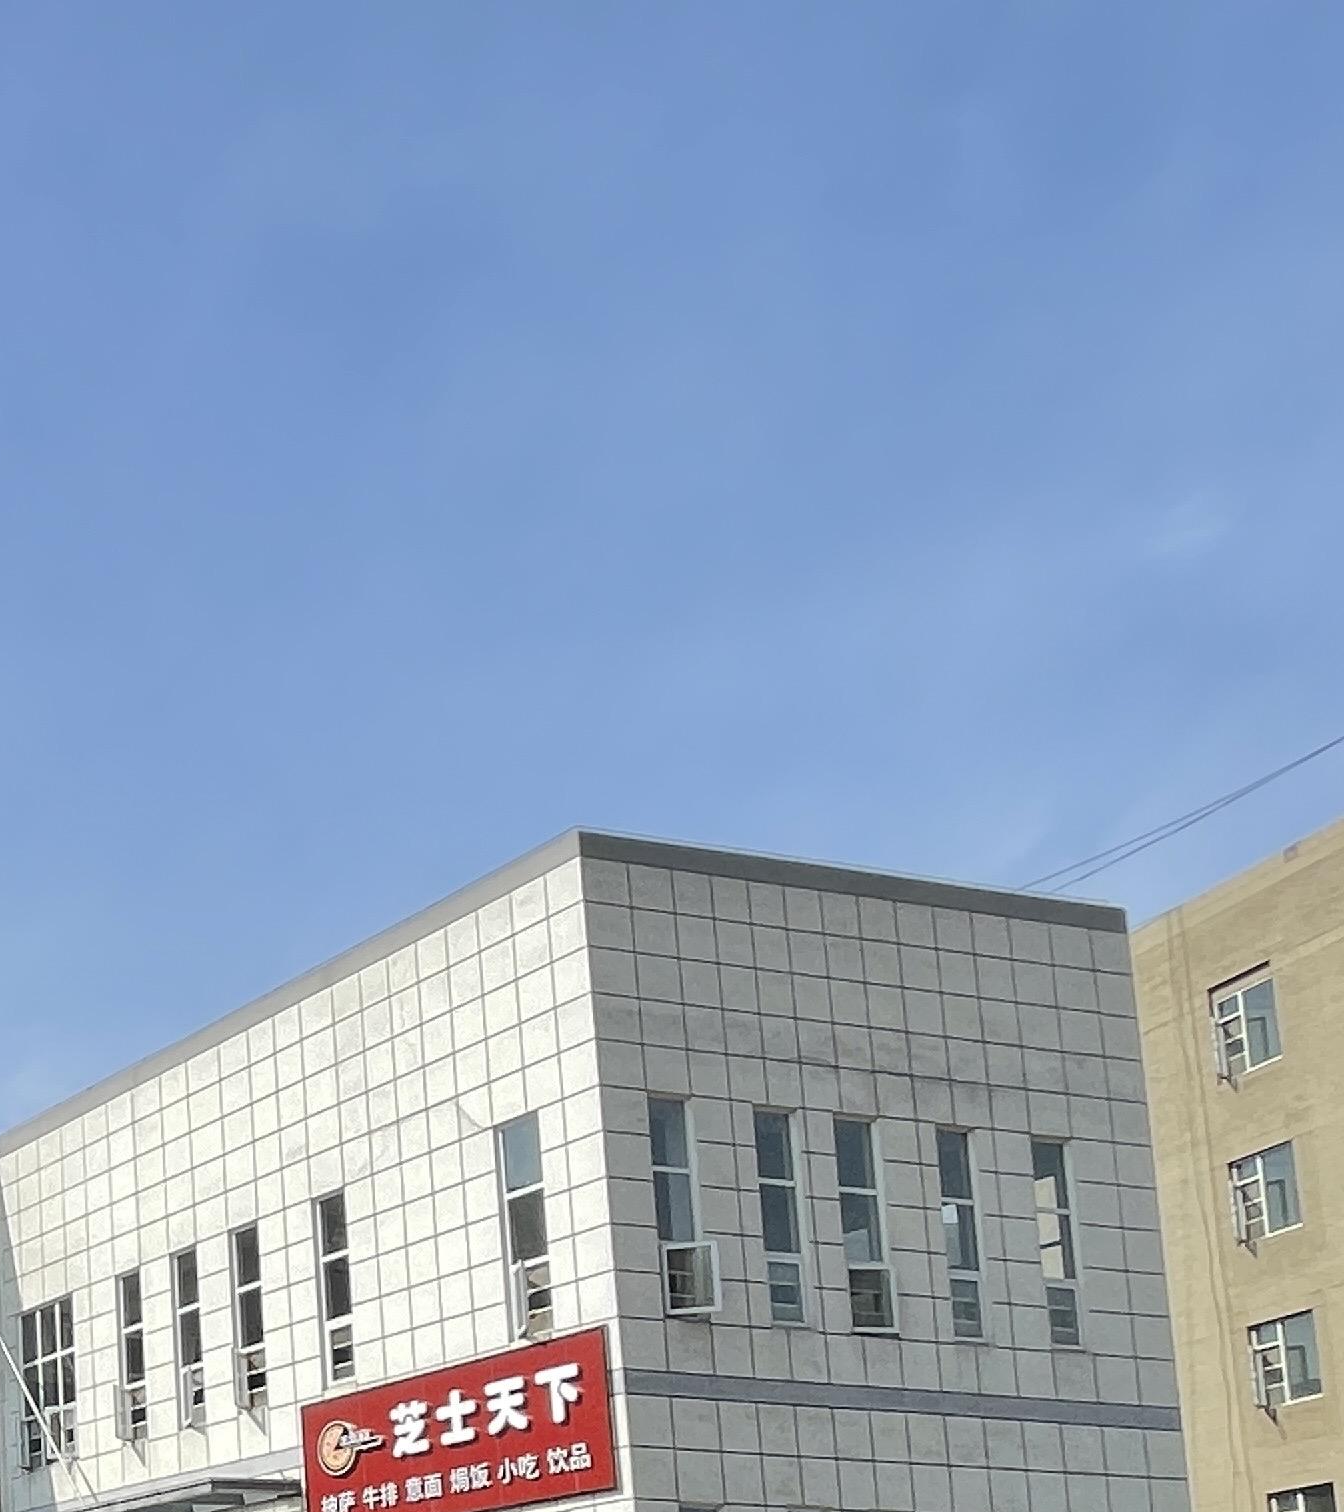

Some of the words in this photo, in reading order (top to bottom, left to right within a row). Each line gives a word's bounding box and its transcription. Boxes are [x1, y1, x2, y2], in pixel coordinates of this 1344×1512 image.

[389, 1362, 584, 1459] 芝士天下
[362, 1481, 399, 1510] 牛排
[404, 1472, 443, 1502] 意面
[449, 1461, 493, 1494] 焗饭
[497, 1453, 540, 1485] 小吃
[547, 1442, 593, 1475] 饮品
